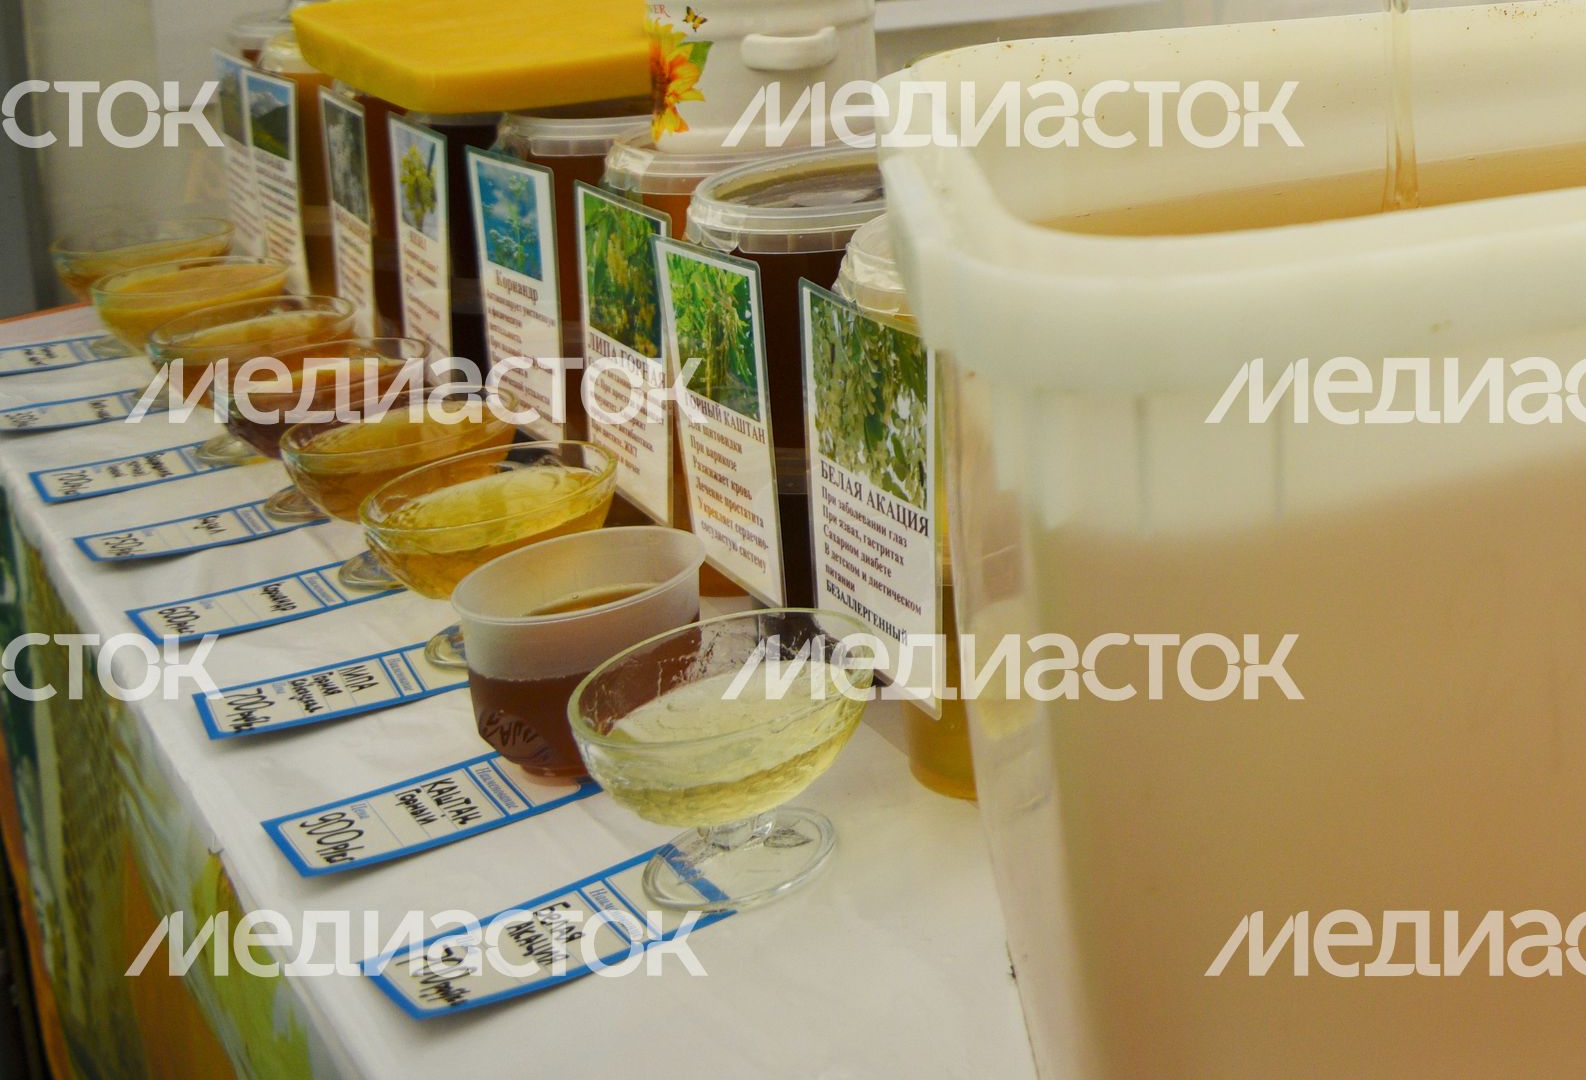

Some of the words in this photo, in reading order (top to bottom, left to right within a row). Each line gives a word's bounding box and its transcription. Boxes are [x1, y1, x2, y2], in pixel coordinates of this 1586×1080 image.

[723, 409, 766, 445] КАШТАН
[820, 459, 864, 502] БЕЛАЯ
[866, 489, 930, 538] АКАЦИЯ
[821, 486, 838, 509] При
[837, 497, 887, 538] заболевании
[888, 530, 908, 549] глаз
[822, 505, 838, 527] При
[863, 534, 905, 566] гастритах
[823, 524, 860, 559] Сахарном
[860, 552, 893, 578] диабете
[824, 543, 830, 556] В
[831, 550, 861, 580] детском
[868, 574, 922, 616] диетическом
[825, 564, 856, 593] питании
